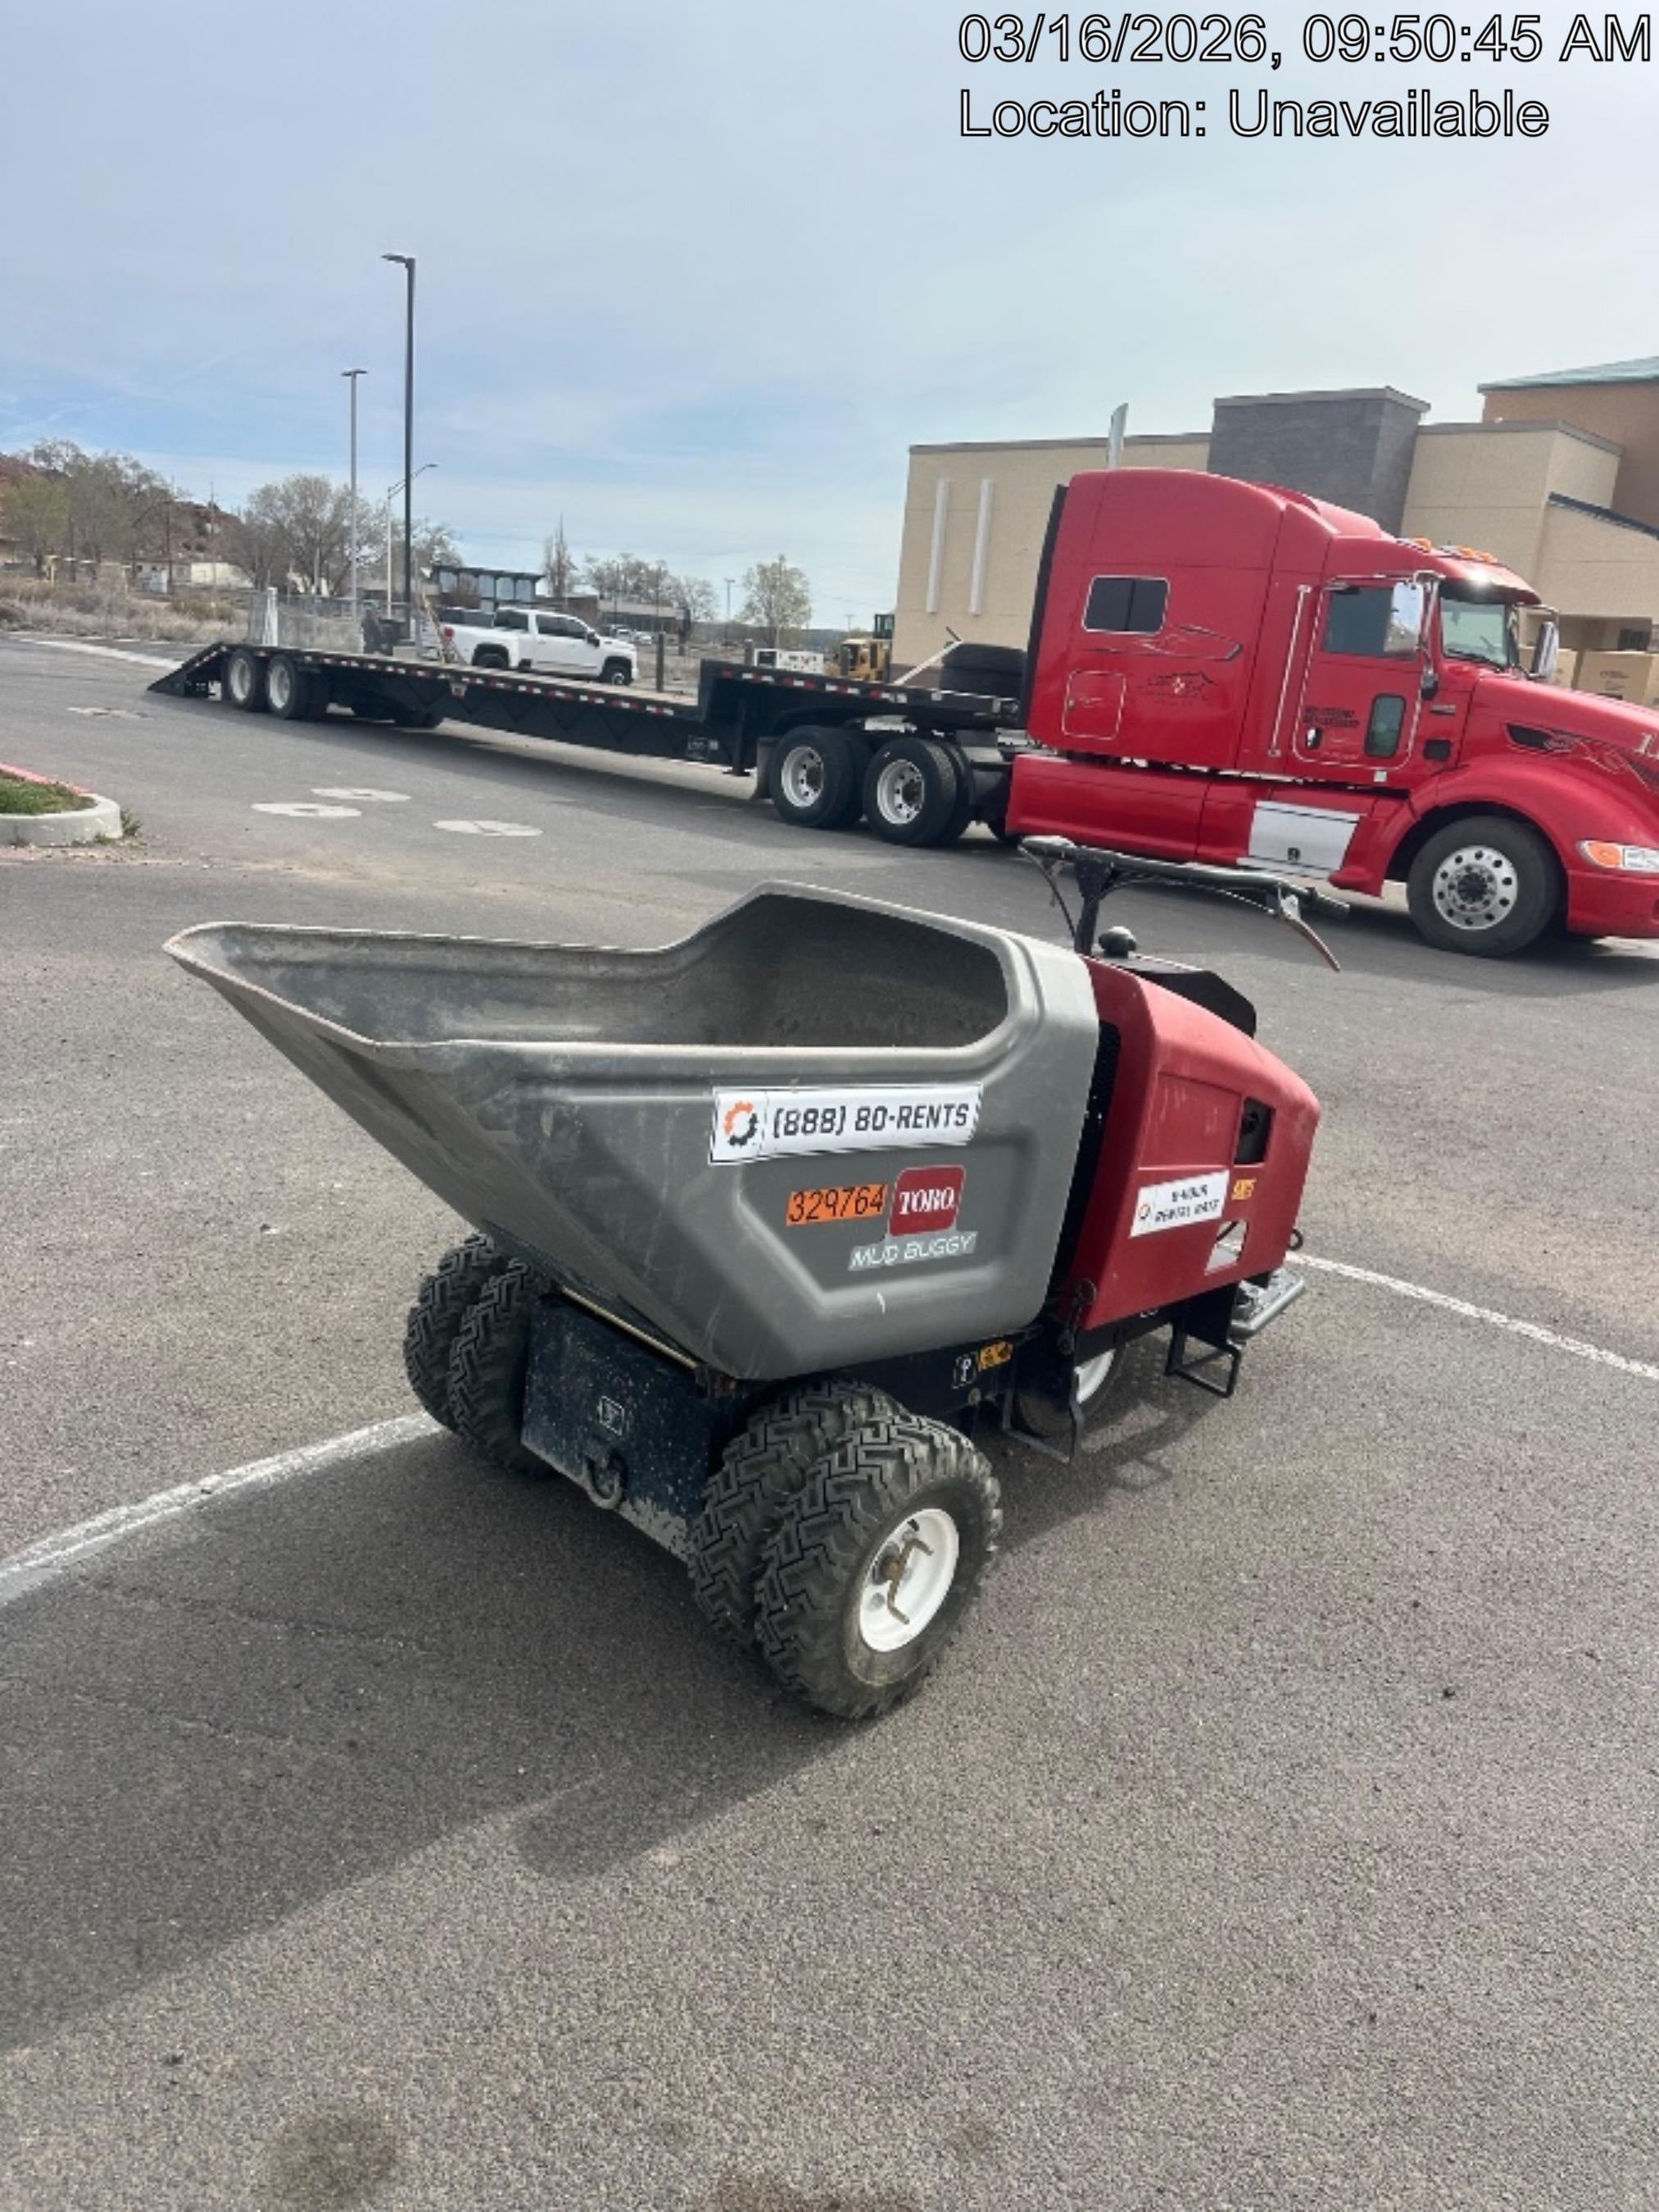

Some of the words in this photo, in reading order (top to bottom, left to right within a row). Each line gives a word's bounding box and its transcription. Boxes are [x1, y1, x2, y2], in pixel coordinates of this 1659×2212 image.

[854, 1104, 969, 1131] 80-RENTS
[789, 1185, 886, 1222] 329764
[852, 1244, 899, 1266] MUD
[904, 1235, 975, 1259] BUGGY
